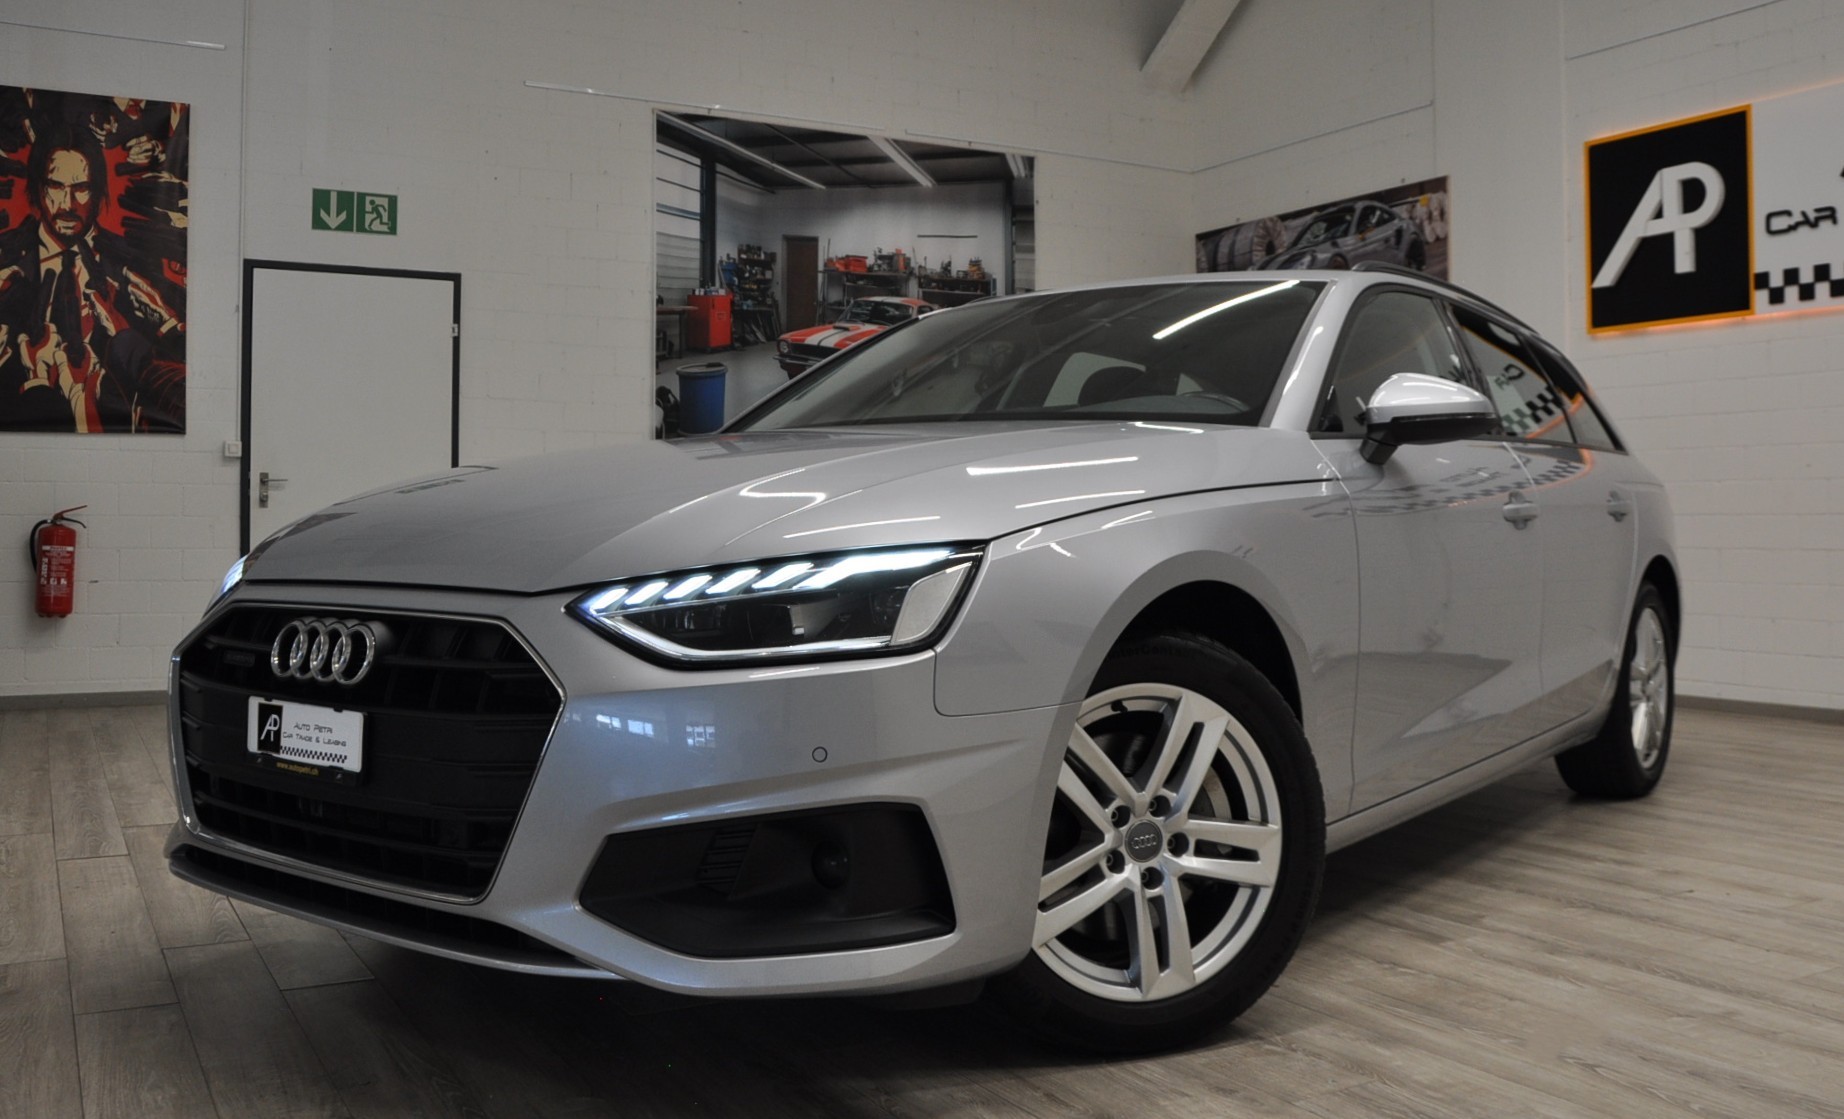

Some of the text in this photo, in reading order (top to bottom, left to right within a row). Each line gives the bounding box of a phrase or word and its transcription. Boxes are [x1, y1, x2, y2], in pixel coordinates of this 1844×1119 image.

[1591, 161, 1726, 289] AP
[1765, 205, 1838, 235] CAR
[260, 713, 280, 742] AP
